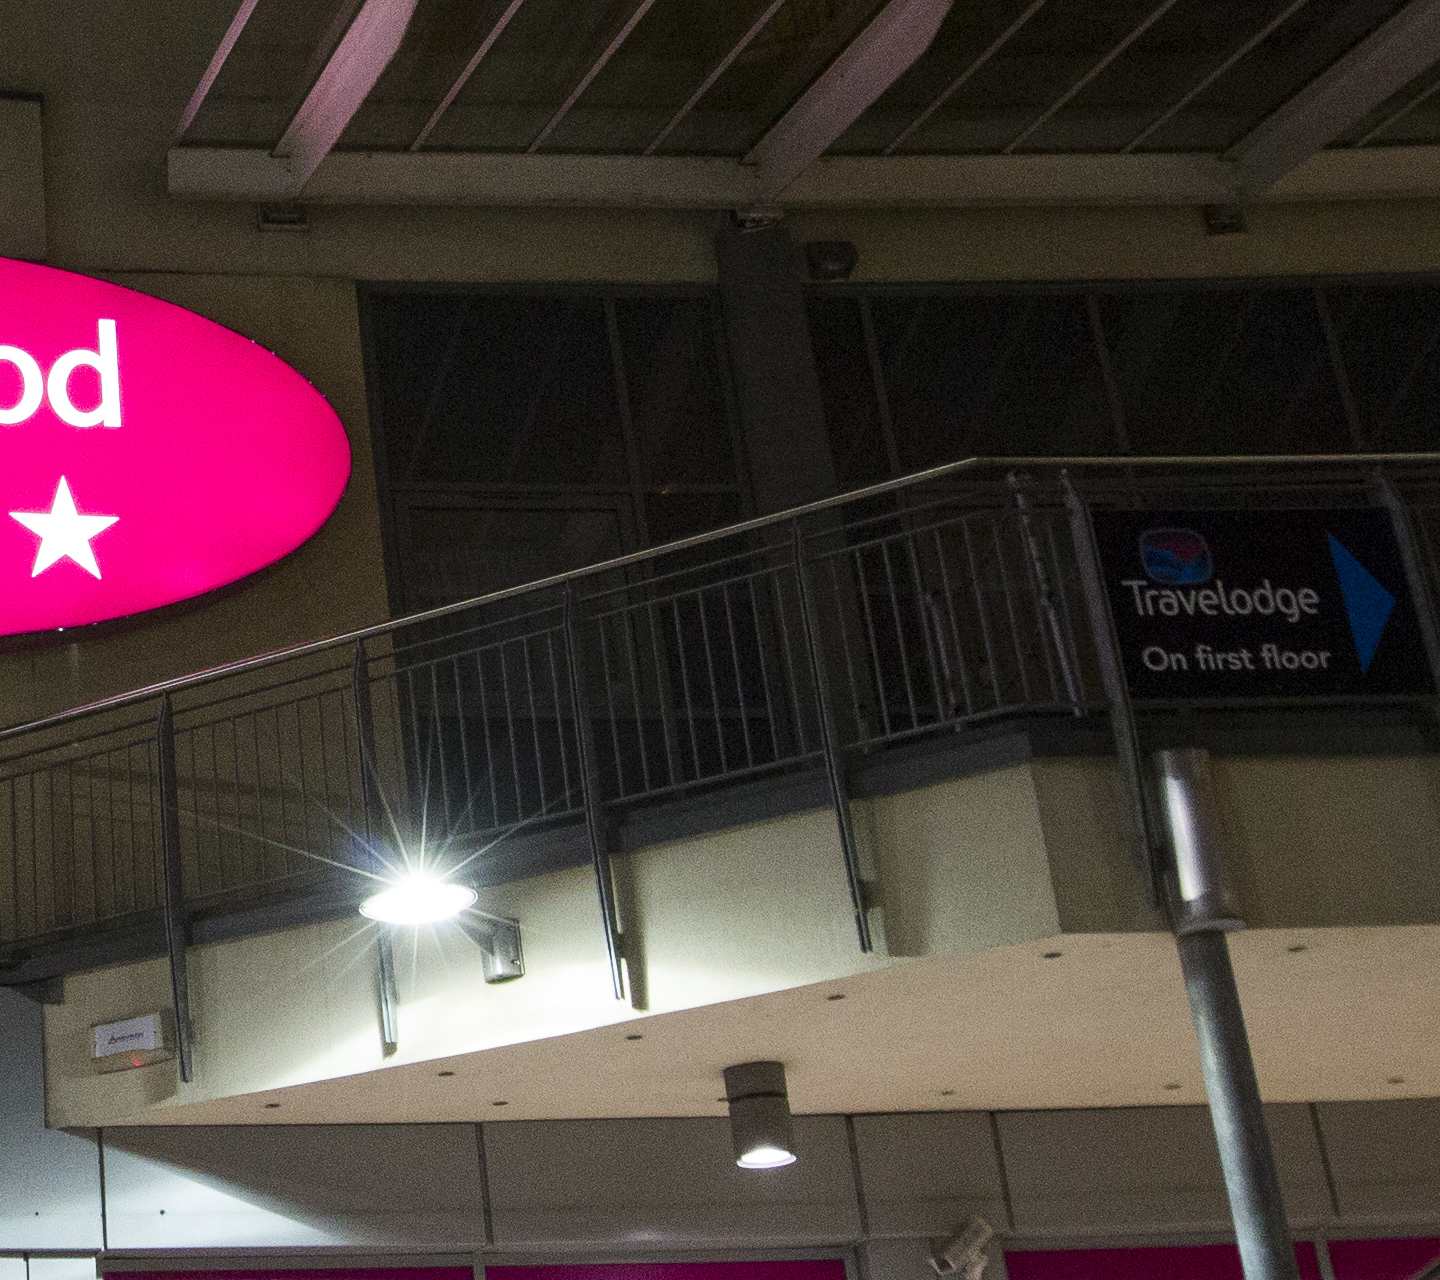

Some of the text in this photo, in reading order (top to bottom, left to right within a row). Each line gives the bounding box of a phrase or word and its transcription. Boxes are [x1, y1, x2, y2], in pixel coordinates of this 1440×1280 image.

[1122, 579, 1320, 622] Travelodge
[1142, 644, 1331, 671] On first floor
